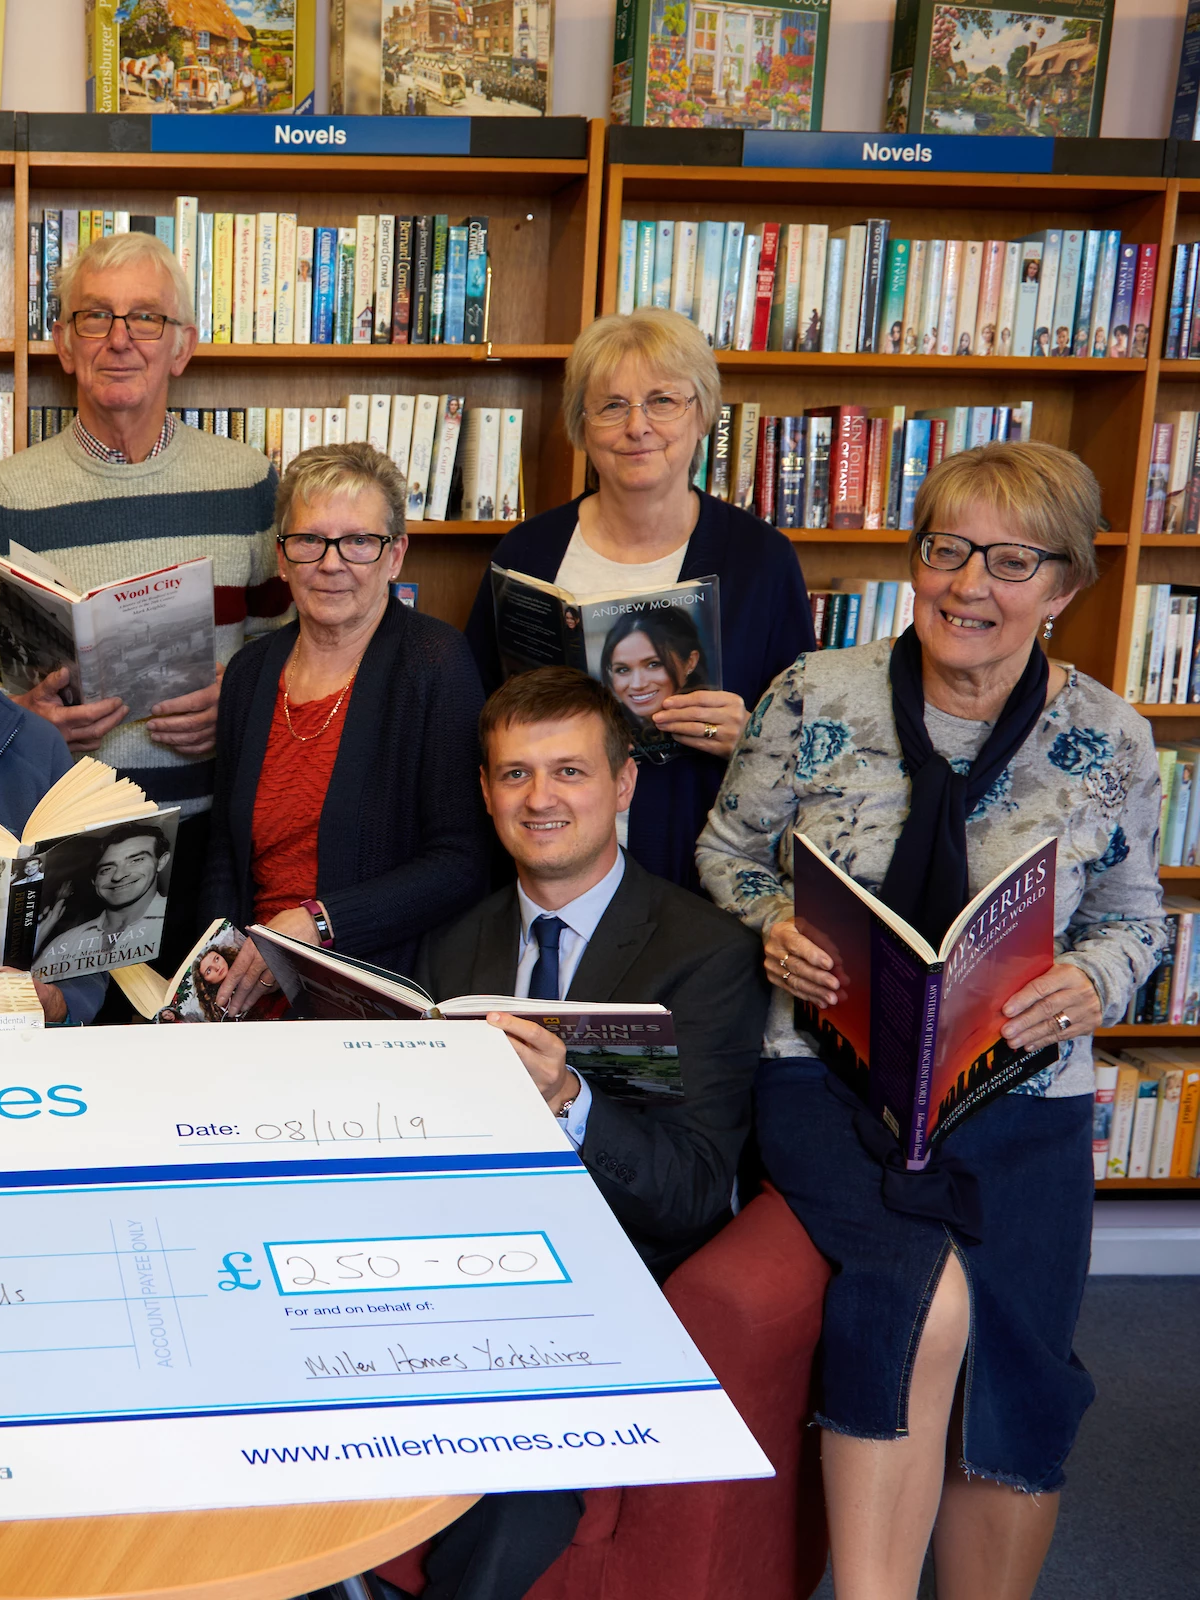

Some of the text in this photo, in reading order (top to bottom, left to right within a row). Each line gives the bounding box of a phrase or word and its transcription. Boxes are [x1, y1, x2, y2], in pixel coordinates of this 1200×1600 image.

[275, 125, 347, 145] Novels
[862, 142, 933, 163] Novels
[320, 232, 331, 264] CATHERINE
[380, 219, 391, 288] Bernard Cornwell
[468, 221, 480, 259] Cornwell
[478, 229, 487, 255] Bernard
[870, 227, 881, 281] GONE GIRL
[319, 266, 330, 294] COOKSON
[360, 235, 371, 296] ALAN COREN
[396, 221, 411, 304] Bernard Cornwell
[417, 231, 429, 292] Bernard Cornwell
[788, 241, 801, 283] Postcard
[892, 257, 902, 291] FLYNN
[1118, 261, 1128, 296] FLYNN
[1138, 261, 1148, 296] FLYNN
[433, 273, 445, 314] SEA LORD
[438, 421, 456, 476] Dilly Court
[716, 410, 731, 458] FLYNN
[742, 411, 755, 458] FLYNN
[838, 415, 851, 502] FALL OF GIANTS
[848, 415, 864, 502] KEN FOLLETT
[113, 577, 183, 603] Wool City
[592, 592, 705, 619] ANDREW MORTON
[24, 890, 36, 927] AS IT WAS
[948, 858, 1047, 978] MYSTERIES
[44, 926, 147, 959] AS IT WAS
[60, 951, 77, 961] The
[120, 942, 130, 952] of
[953, 958, 971, 984] THE
[970, 920, 1007, 961] ANCIENT
[1009, 886, 1047, 919] WORLD
[34, 943, 157, 980] FRED TRUEMAN
[927, 984, 937, 1023] MYSTERIES
[546, 1024, 661, 1032] ST LINES
[557, 1031, 630, 1039] ITAIN
[924, 1032, 933, 1048] THE
[921, 1049, 932, 1080] ANCIENT
[966, 1047, 1044, 1101] OF THE ANCIENT WORLD
[917, 1080, 928, 1106] WORLD
[972, 1066, 1023, 1104] AND EXPLAINED
[1119, 1082, 1129, 1112] LEWIS
[1181, 1084, 1198, 1124] Capital
[176, 1122, 240, 1138] Date:
[254, 1102, 427, 1145] 08/10/19
[218, 1251, 261, 1291] £
[126, 1219, 174, 1369] ACCOUNT PAYEE ONLY
[284, 1301, 435, 1318] For and on behalf of:
[304, 1338, 592, 1377] Miller Homes Yorkshire
[240, 1423, 661, 1466] www.millerhomes.co.uk
